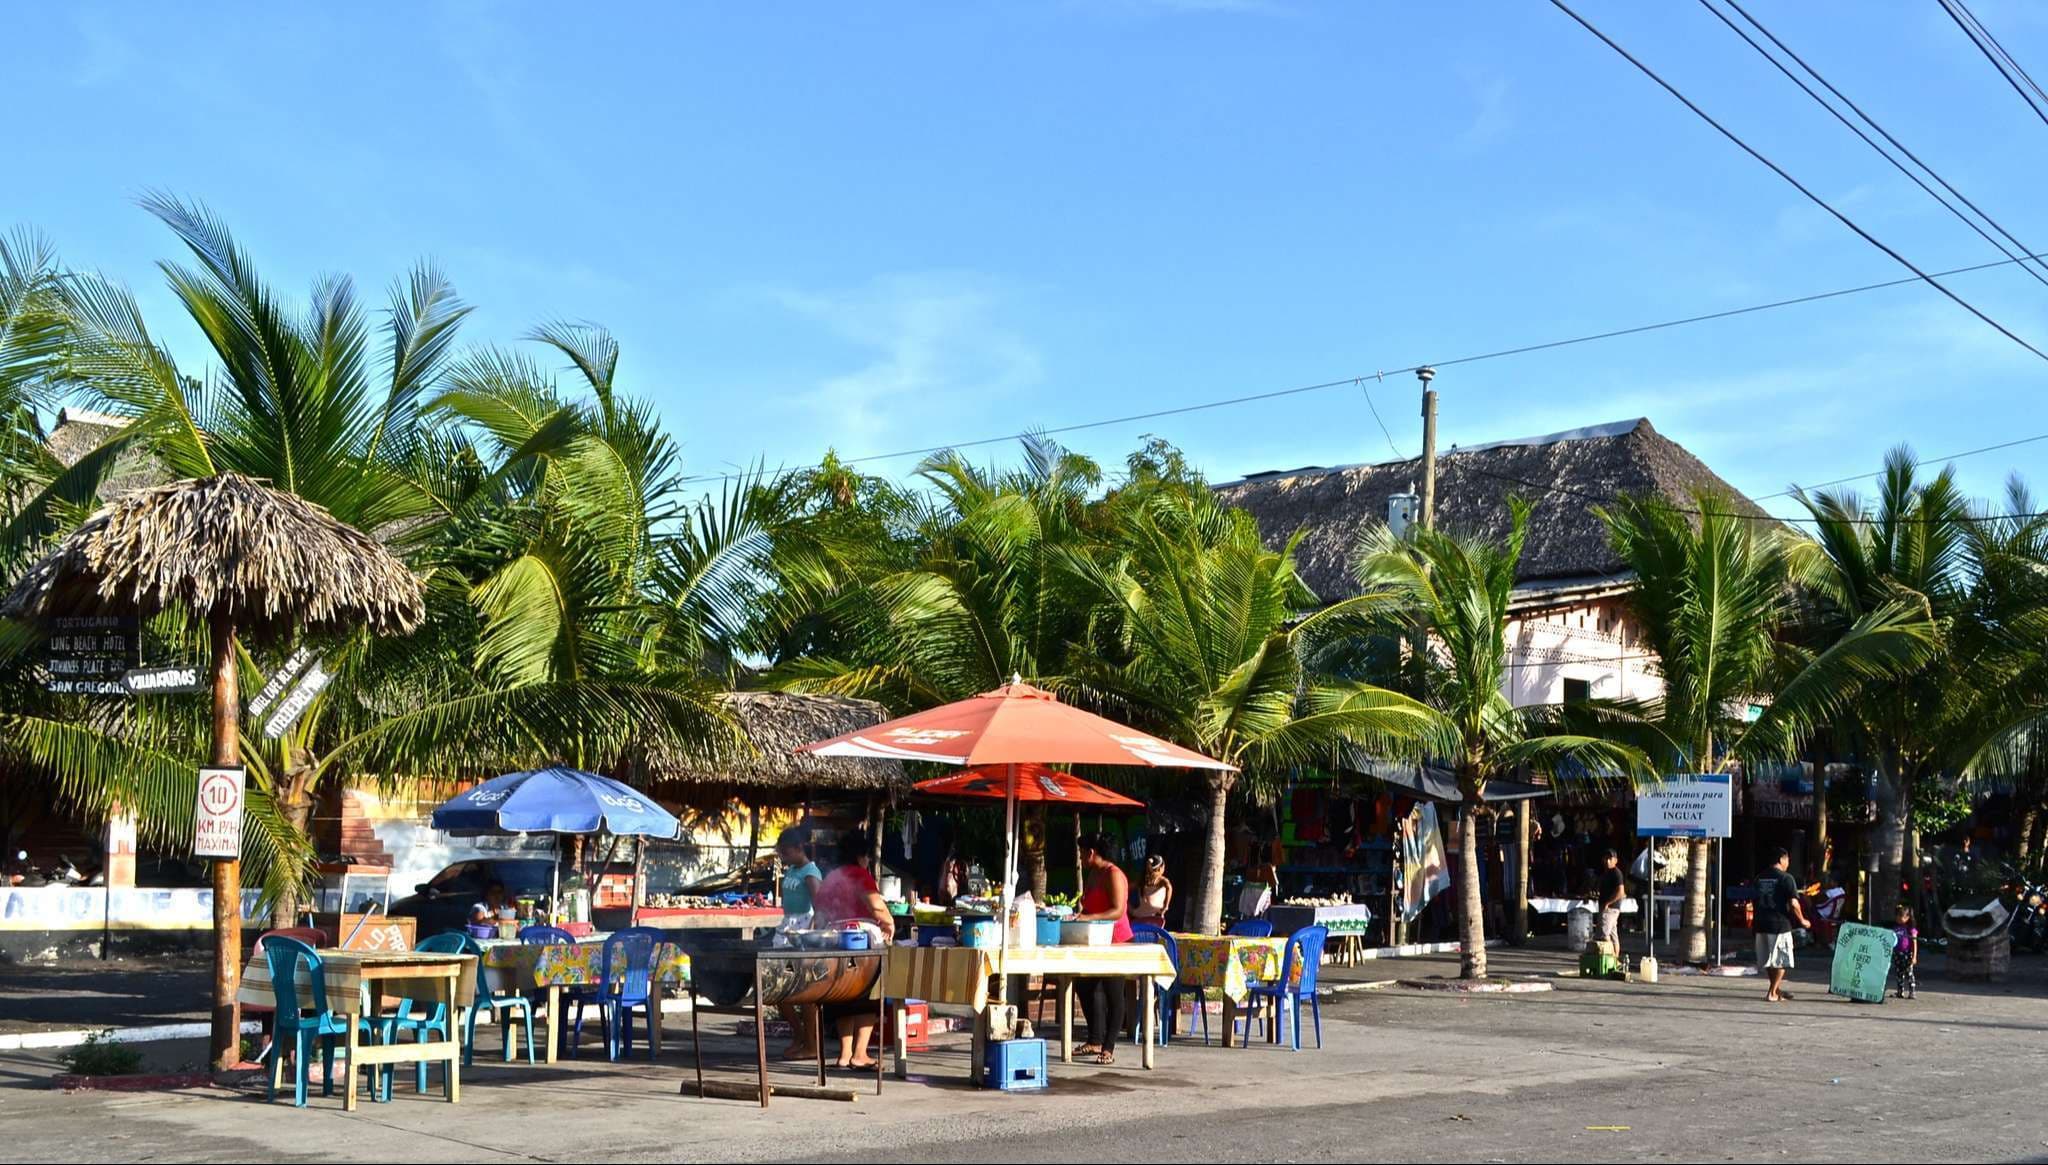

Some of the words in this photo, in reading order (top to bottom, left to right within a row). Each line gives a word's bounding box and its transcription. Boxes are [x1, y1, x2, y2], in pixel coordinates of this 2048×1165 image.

[50, 636, 70, 651] LONG
[73, 635, 97, 651] BEACH
[103, 635, 126, 651] HOTEL
[82, 659, 105, 673] PLACE
[48, 681, 73, 692] SAN
[209, 786, 227, 804] 10
[1702, 791, 1724, 801] para
[1661, 801, 1670, 809] el
[1672, 801, 1706, 809] turismo
[1663, 811, 1705, 820] INGUAT
[197, 837, 236, 851] MAXIMA
